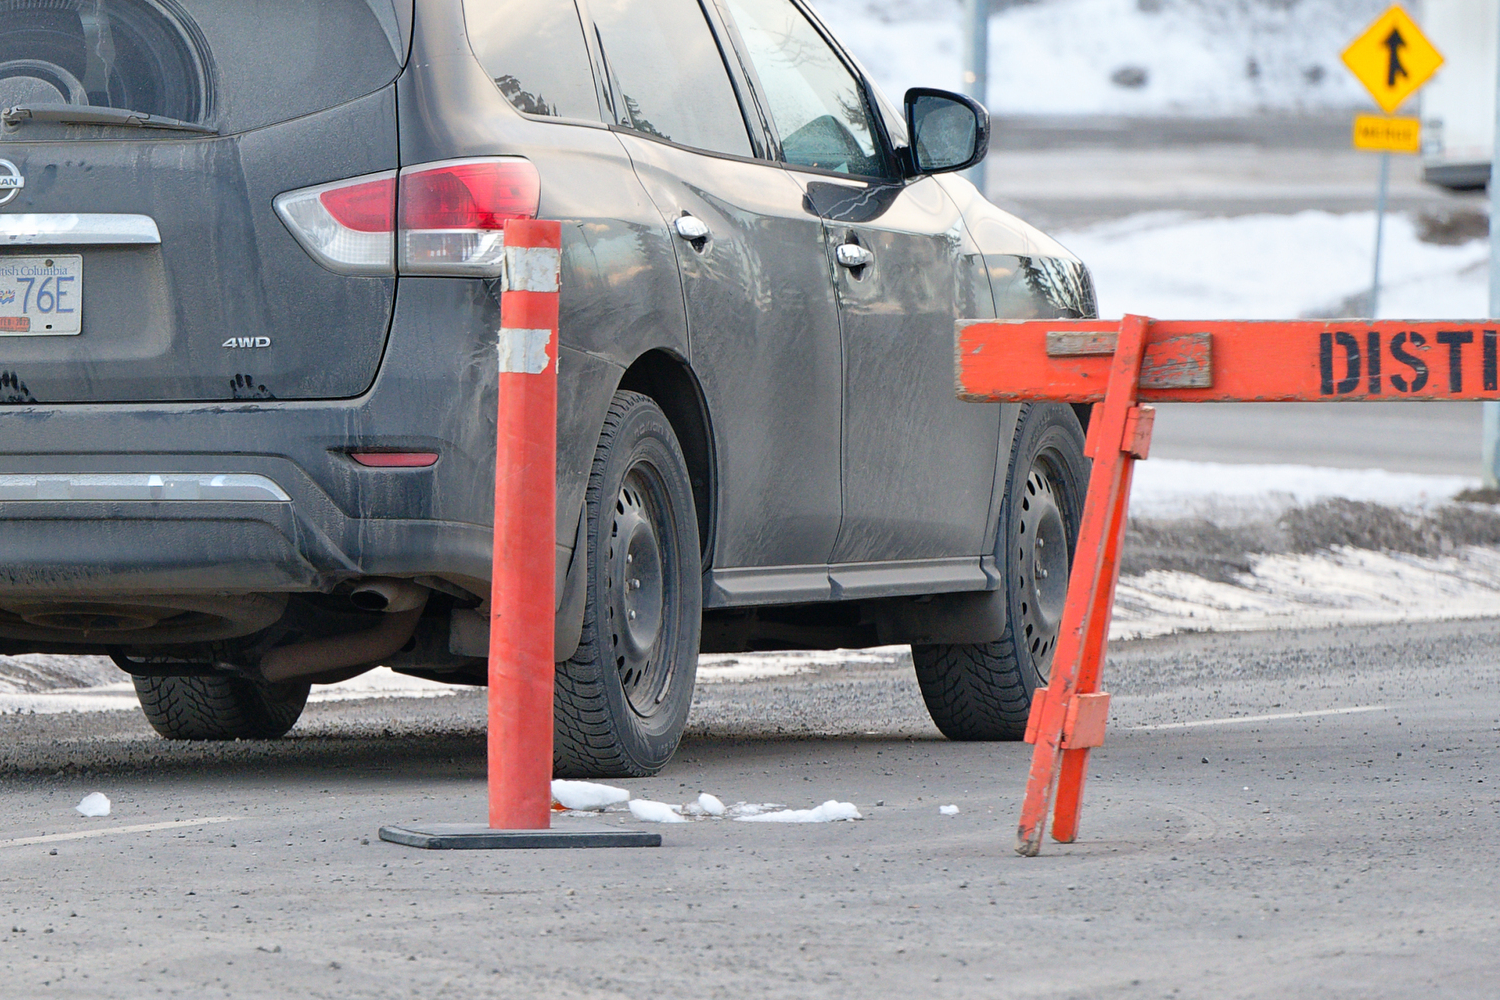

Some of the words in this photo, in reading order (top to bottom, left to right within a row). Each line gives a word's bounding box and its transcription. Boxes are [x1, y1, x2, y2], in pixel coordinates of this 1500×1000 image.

[20, 265, 68, 276] Columbia
[16, 276, 75, 314] 76E
[222, 336, 271, 348] 4WD
